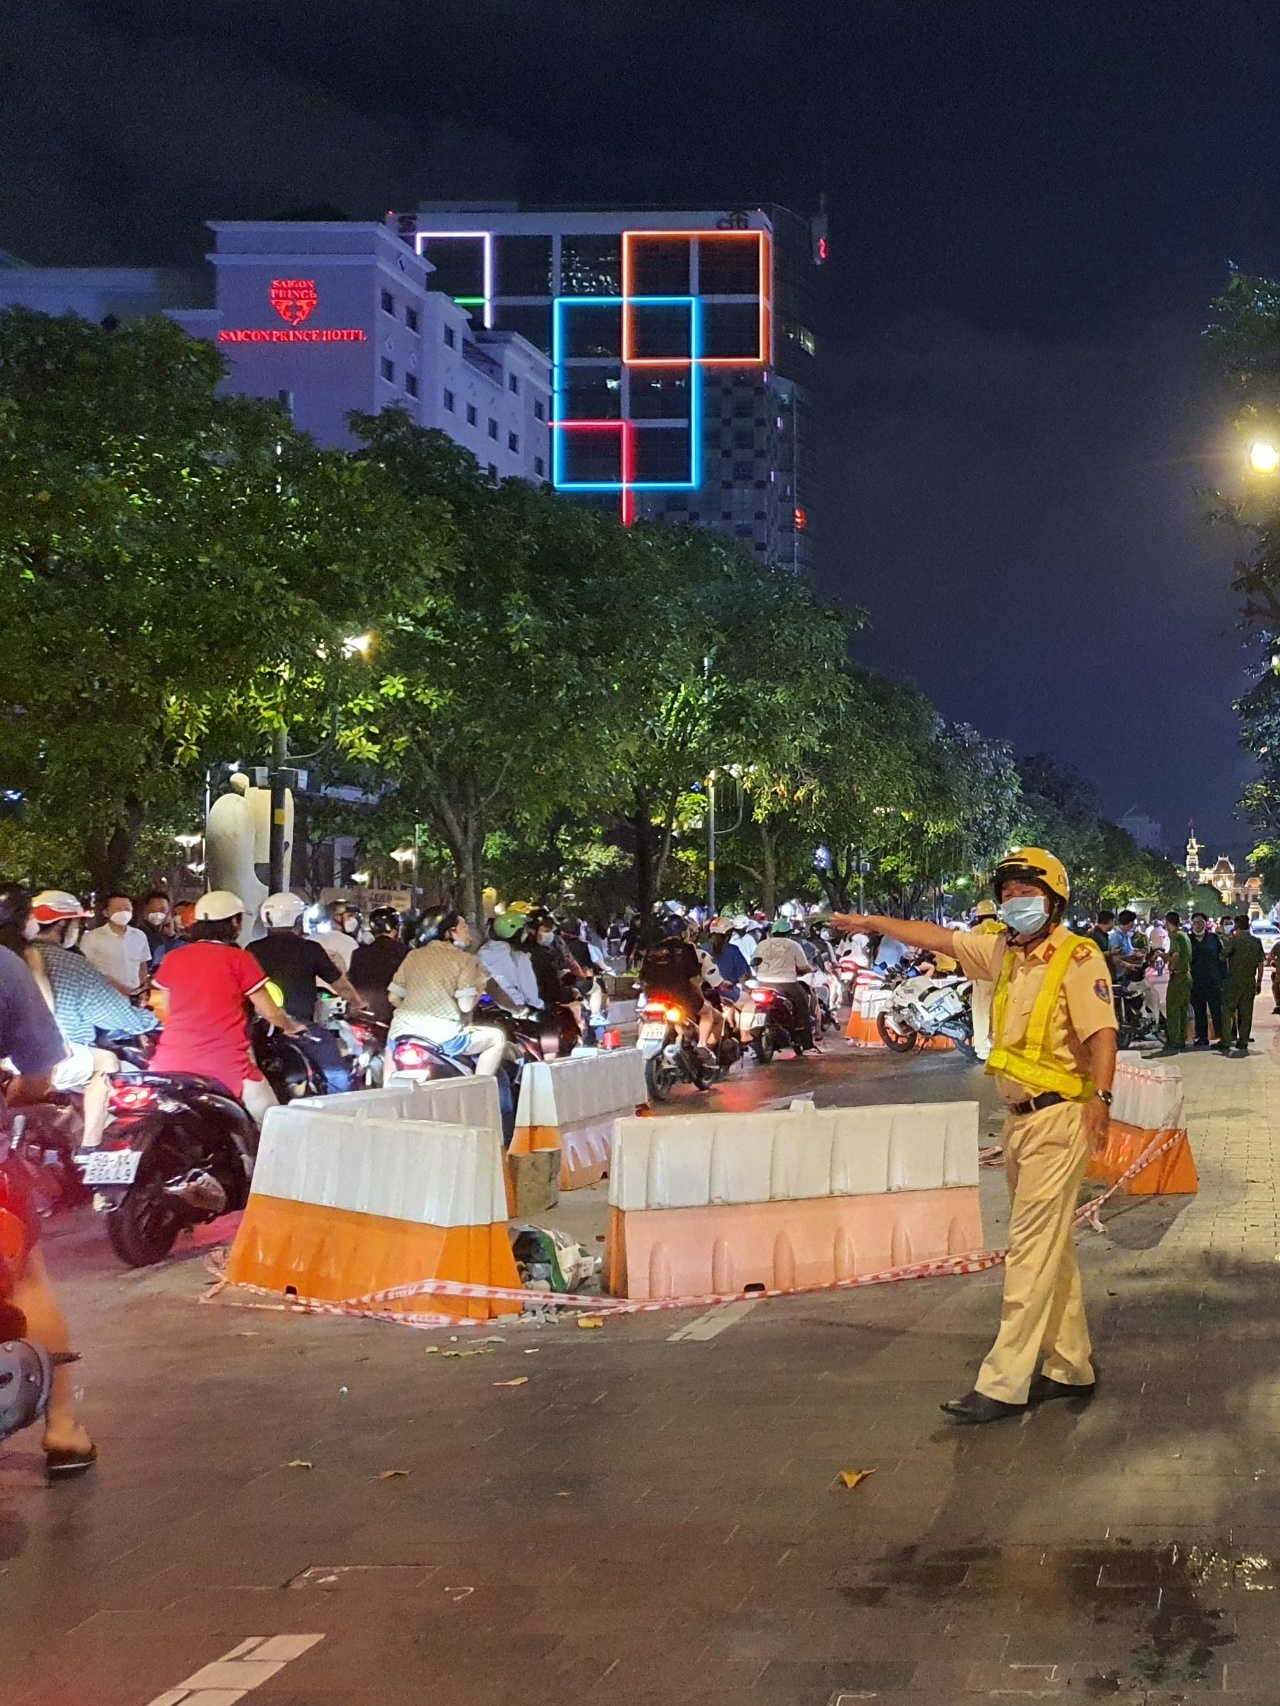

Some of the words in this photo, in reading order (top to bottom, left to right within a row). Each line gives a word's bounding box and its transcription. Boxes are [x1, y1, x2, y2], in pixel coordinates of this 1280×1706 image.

[272, 280, 315, 288] SAIGON
[271, 289, 317, 299] PRINCE
[219, 330, 270, 342] SAIGON
[272, 330, 320, 342] PRINCE
[322, 329, 367, 341] HOTEL
